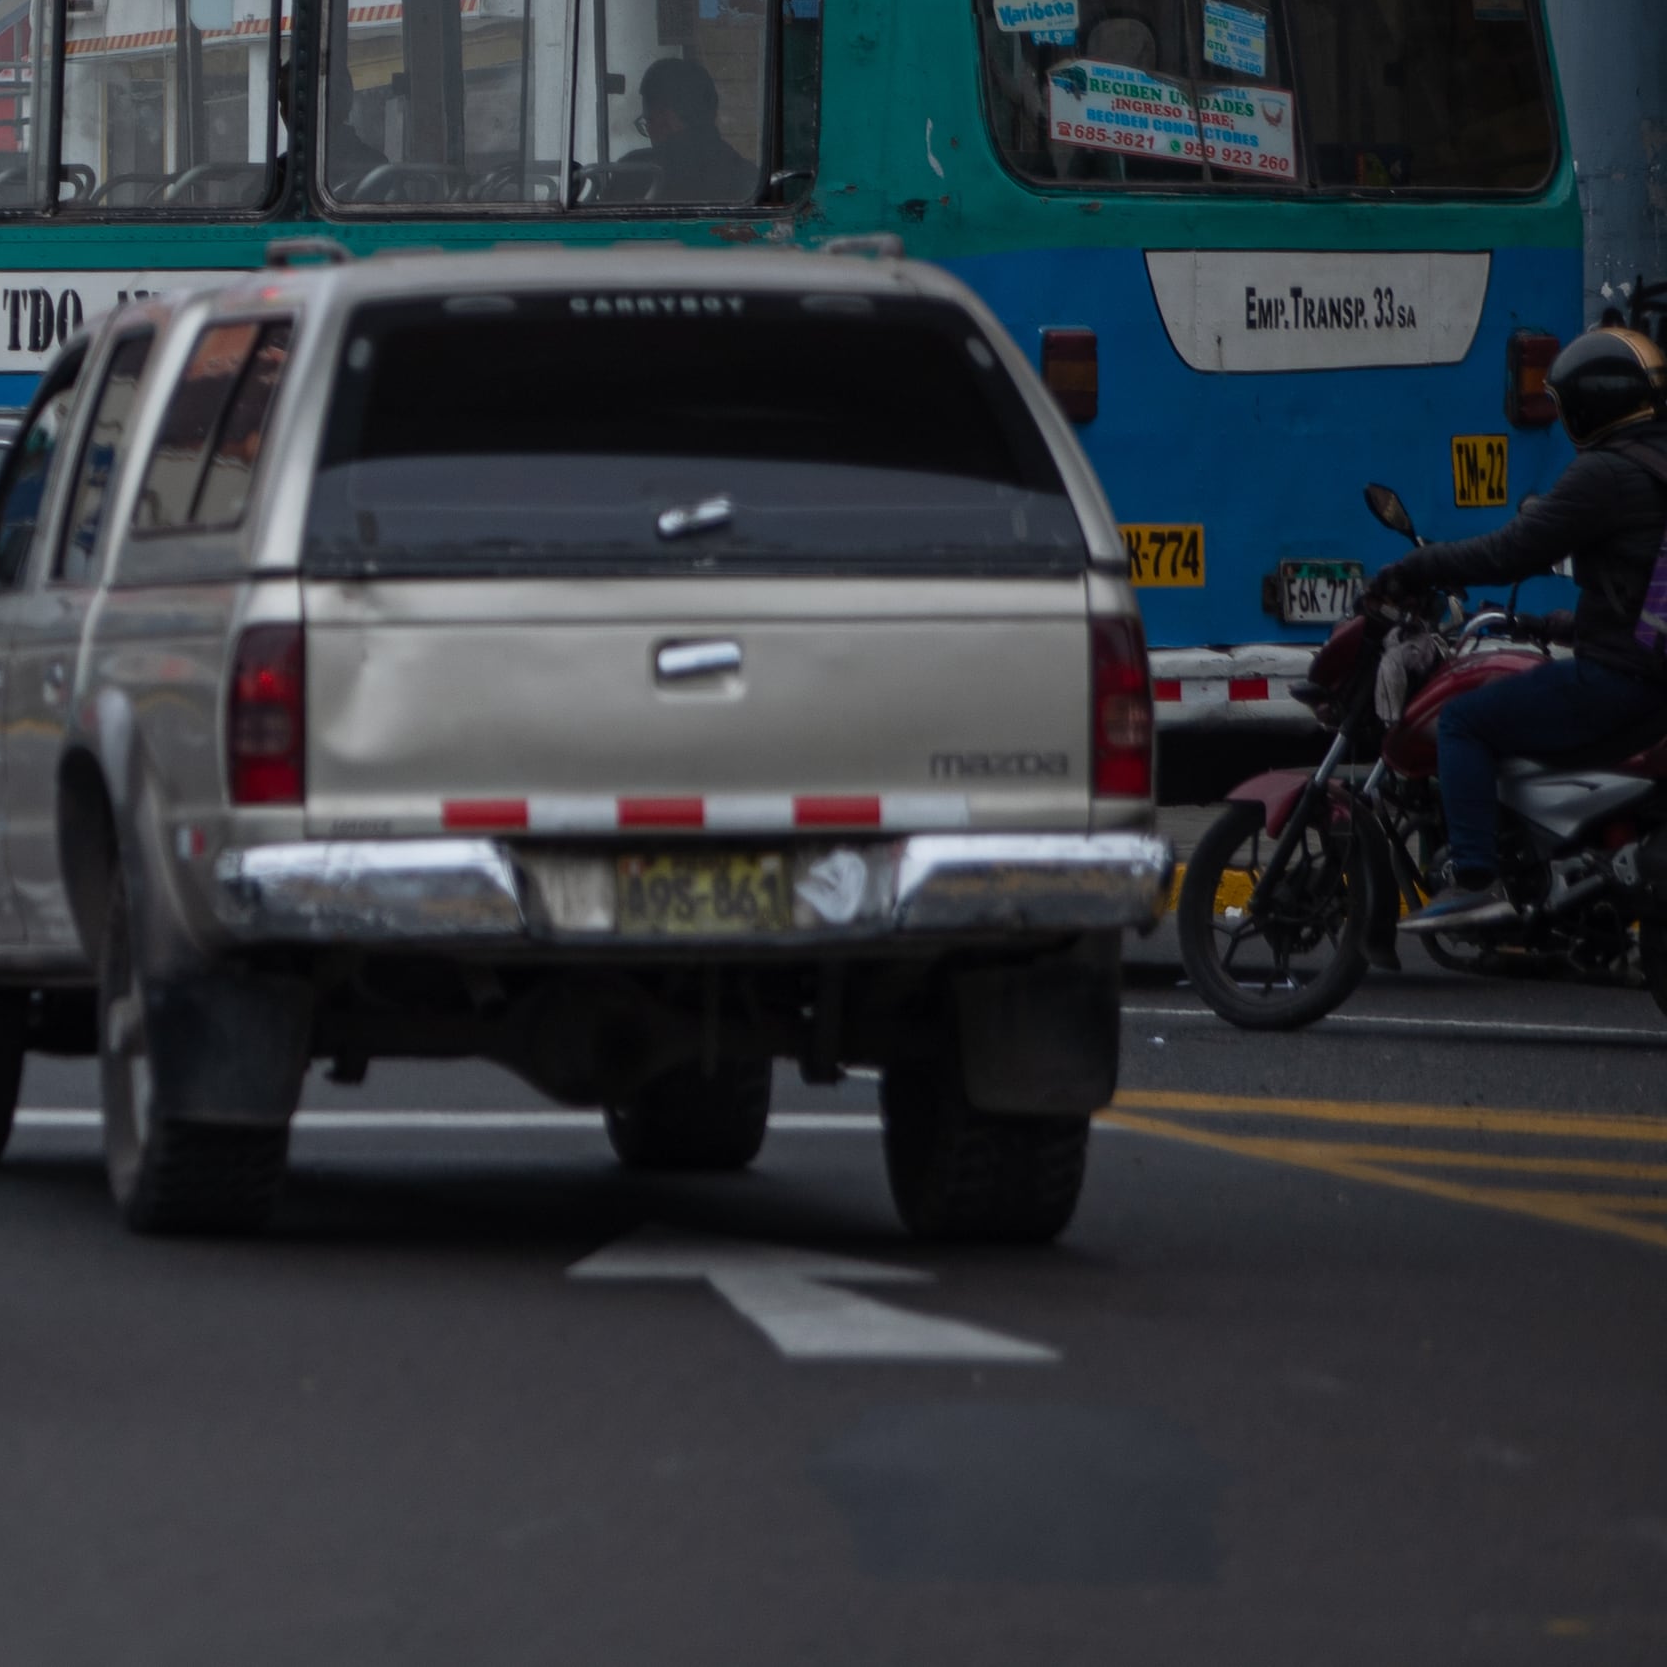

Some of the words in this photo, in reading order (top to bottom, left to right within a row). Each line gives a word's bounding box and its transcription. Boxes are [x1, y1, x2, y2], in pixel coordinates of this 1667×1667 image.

[1089, 77, 1162, 102] RECIBEN
[1169, 90, 1255, 118] UNDADES
[1074, 124, 1155, 150] 685-3621
[1221, 145, 1252, 166] 923
[1258, 151, 1290, 172] 260
[569, 295, 745, 318] CARRYBOY
[1374, 287, 1394, 329] 33
[1455, 442, 1504, 501] IM-22
